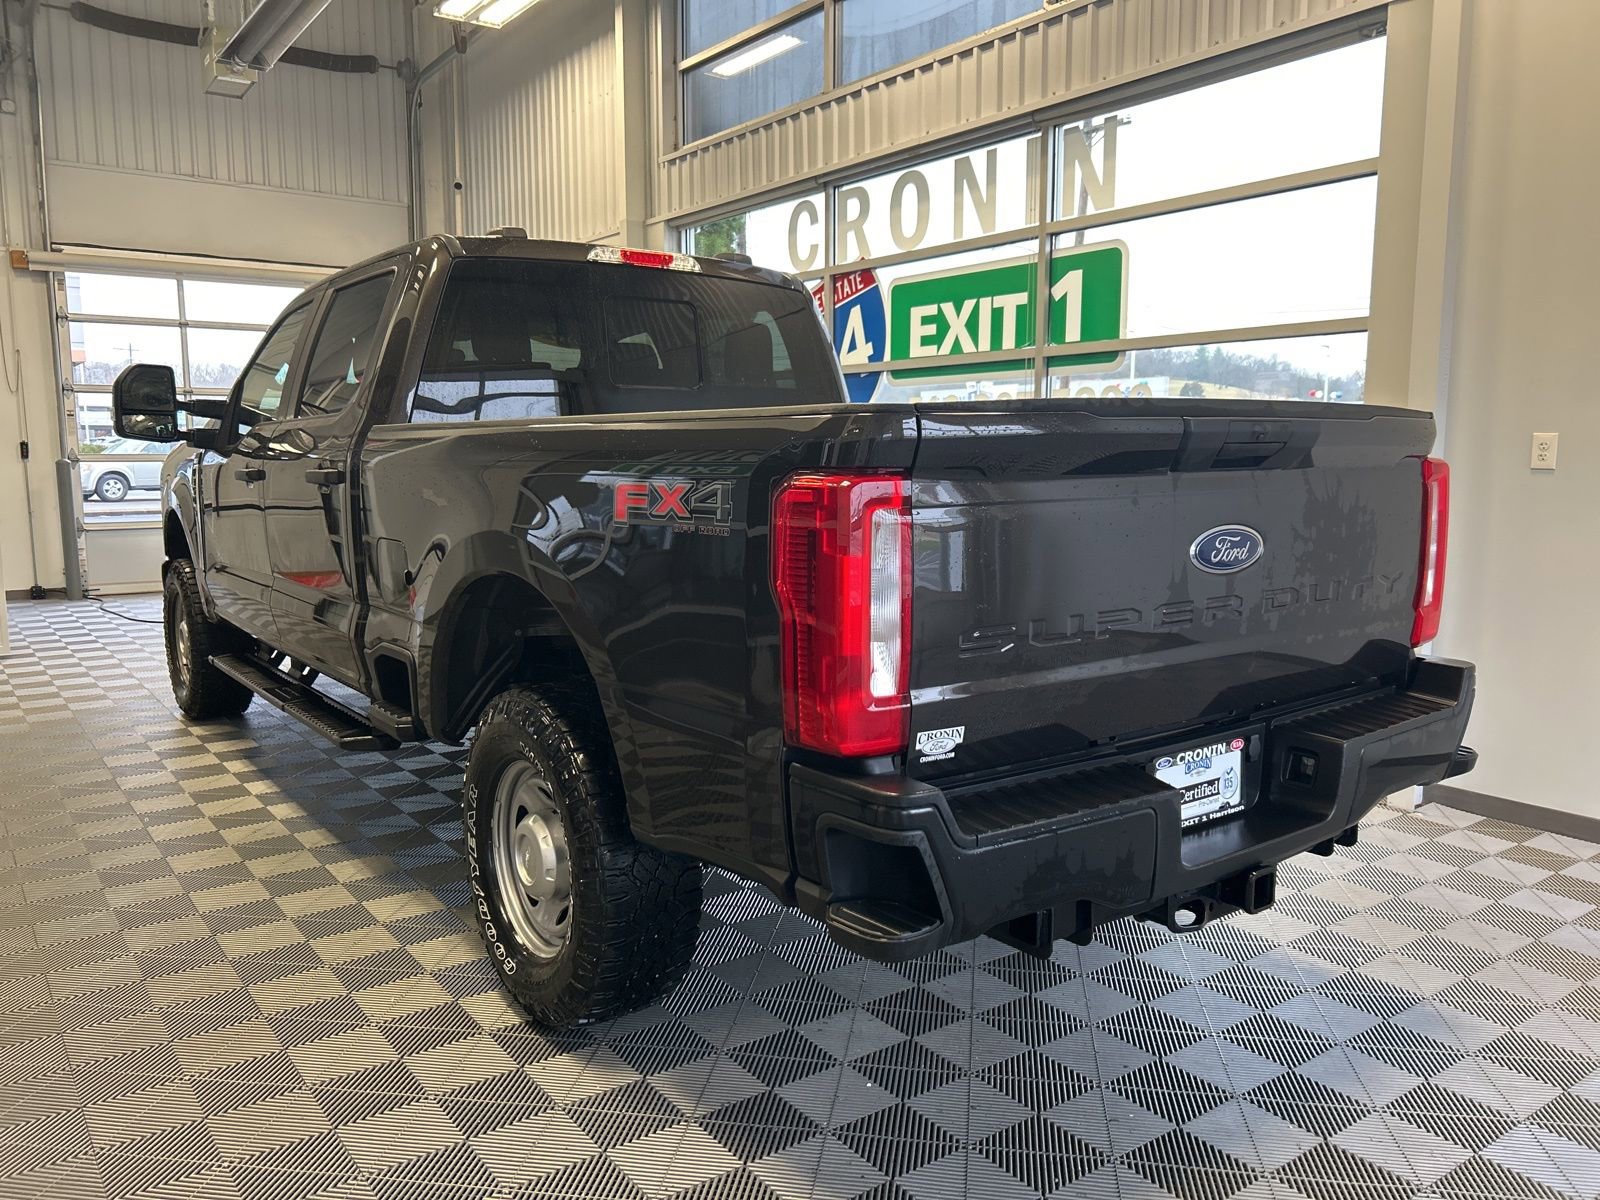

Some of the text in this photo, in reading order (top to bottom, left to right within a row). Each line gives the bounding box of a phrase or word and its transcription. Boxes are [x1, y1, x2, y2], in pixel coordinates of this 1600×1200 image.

[788, 115, 1119, 274] CRONIN
[909, 269, 1085, 359] EXIT 1
[613, 480, 733, 527] FX4
[672, 523, 731, 537] OFF ROAD
[1209, 535, 1251, 563] Ford
[958, 571, 1405, 659] SUPER DUTY
[918, 727, 964, 745] CRONIN
[929, 740, 949, 752] Ford
[1176, 743, 1227, 765] CRONIN
[1185, 758, 1212, 774] CRONIN
[1179, 780, 1219, 803] Certified
[1209, 804, 1245, 819] Harrison
[467, 783, 517, 976] GOODYEAR
